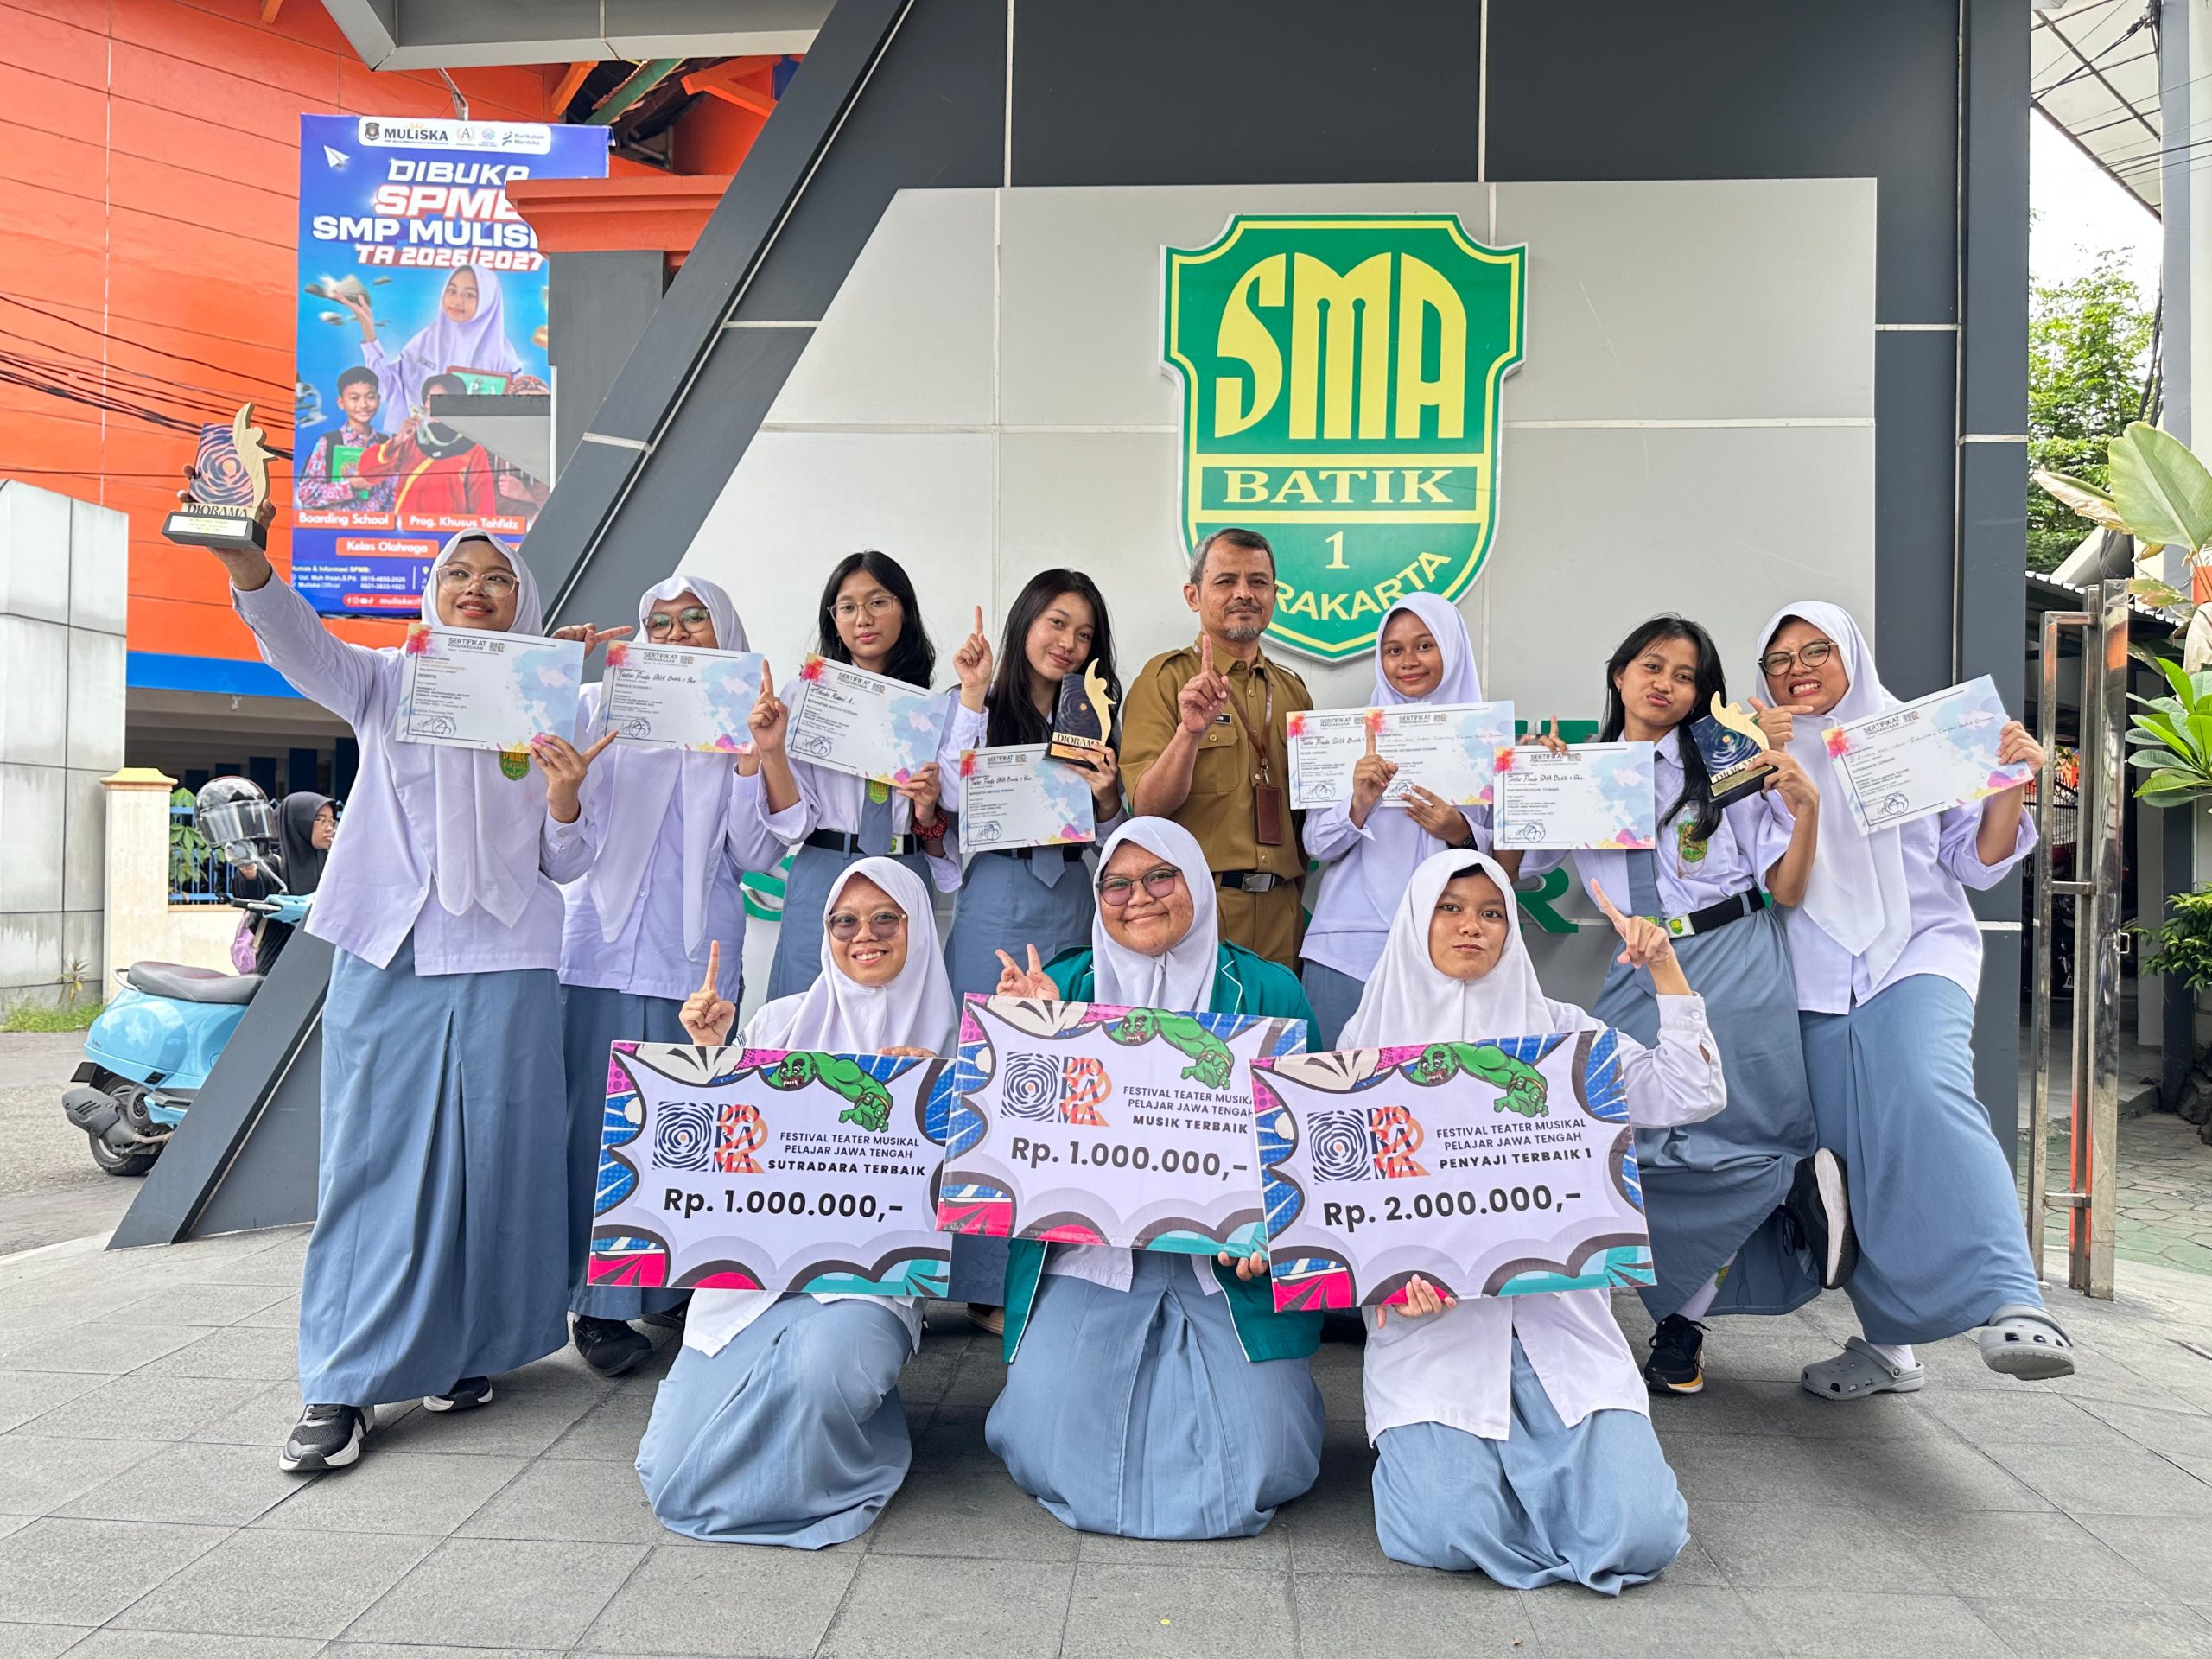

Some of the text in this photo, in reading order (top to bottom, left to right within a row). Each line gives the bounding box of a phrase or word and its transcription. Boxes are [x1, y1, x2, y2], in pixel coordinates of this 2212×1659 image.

[312, 215, 401, 242] SMP
[355, 243, 400, 265] TA
[1214, 251, 1466, 439] SMA
[1222, 469, 1453, 503] BATIK
[187, 504, 248, 518] DIORAMA
[298, 512, 389, 525] Boarding School
[410, 515, 518, 529] Prog. Khusus Tahfidz
[346, 540, 428, 554] Kelas Olahraga
[1325, 531, 1350, 569] 1
[1275, 551, 1452, 620] RAKARTA
[448, 637, 487, 647] SERTIFIKAT
[838, 672, 871, 686] SERTIFIKAT
[1863, 716, 1900, 734] SERTIFIKAT
[1122, 1085, 1172, 1098] FESTIVAL
[1174, 1090, 1212, 1102] TEATER
[716, 1103, 760, 1122] DIO
[1128, 1098, 1173, 1111] PELAJAR
[1176, 1103, 1209, 1113] JAWA
[1132, 1115, 1248, 1134] MUSIK TERBAIK
[1366, 1105, 1411, 1127] DIO
[714, 1126, 757, 1149] RA
[1436, 1118, 1586, 1138] FESTIVAL TEATER MUSIKAL
[780, 1132, 919, 1147] FESTIVAL TEATER MUSIKAL
[1369, 1127, 1417, 1154] RA
[1444, 1132, 1582, 1150] PELAJAR JAWA TENGAH
[785, 1145, 912, 1159] PELAJAR JAWA TENGAH
[1011, 1136, 1247, 1181] Rp. 1.000.000,-
[1439, 1147, 1592, 1169] PENYAJI TERBAIK 1
[711, 1152, 753, 1173] MA
[768, 1160, 925, 1176] SUTRADARA TERBAIK
[1373, 1156, 1419, 1179] MA
[664, 1188, 902, 1222] Rp. 1.000.000,-
[1323, 1185, 1581, 1232] Rp. 2.000.000,-
